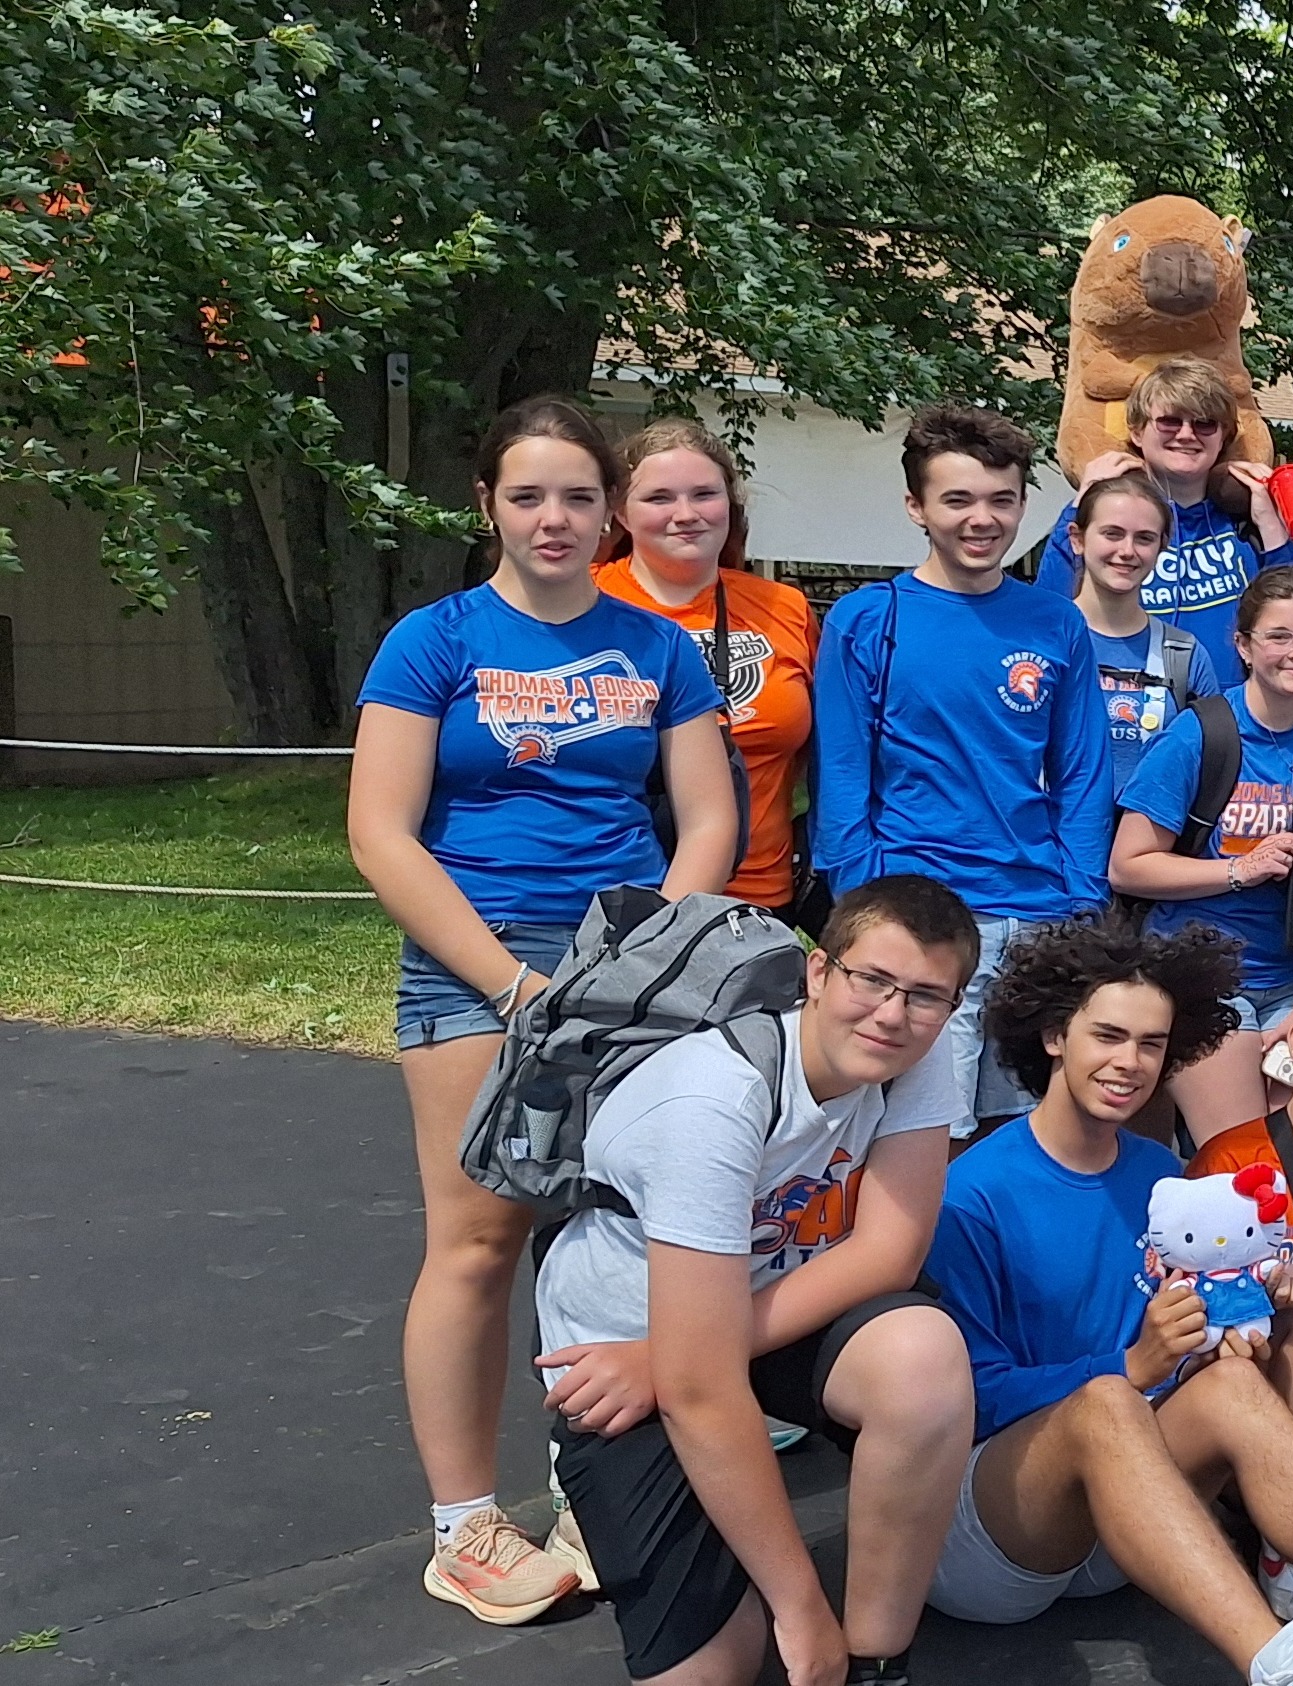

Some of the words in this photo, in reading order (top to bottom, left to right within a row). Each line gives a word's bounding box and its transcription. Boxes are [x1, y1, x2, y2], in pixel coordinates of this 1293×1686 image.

[1142, 539, 1235, 586] OLLY
[1140, 573, 1241, 605] RANCHER
[1000, 651, 1050, 670] SPARTAN
[475, 670, 567, 697] THOMAS
[573, 677, 589, 698] A
[592, 675, 660, 699] EDISON
[476, 694, 579, 724] TRACK
[597, 699, 658, 727] FIELD
[1221, 803, 1293, 836] SPAR
